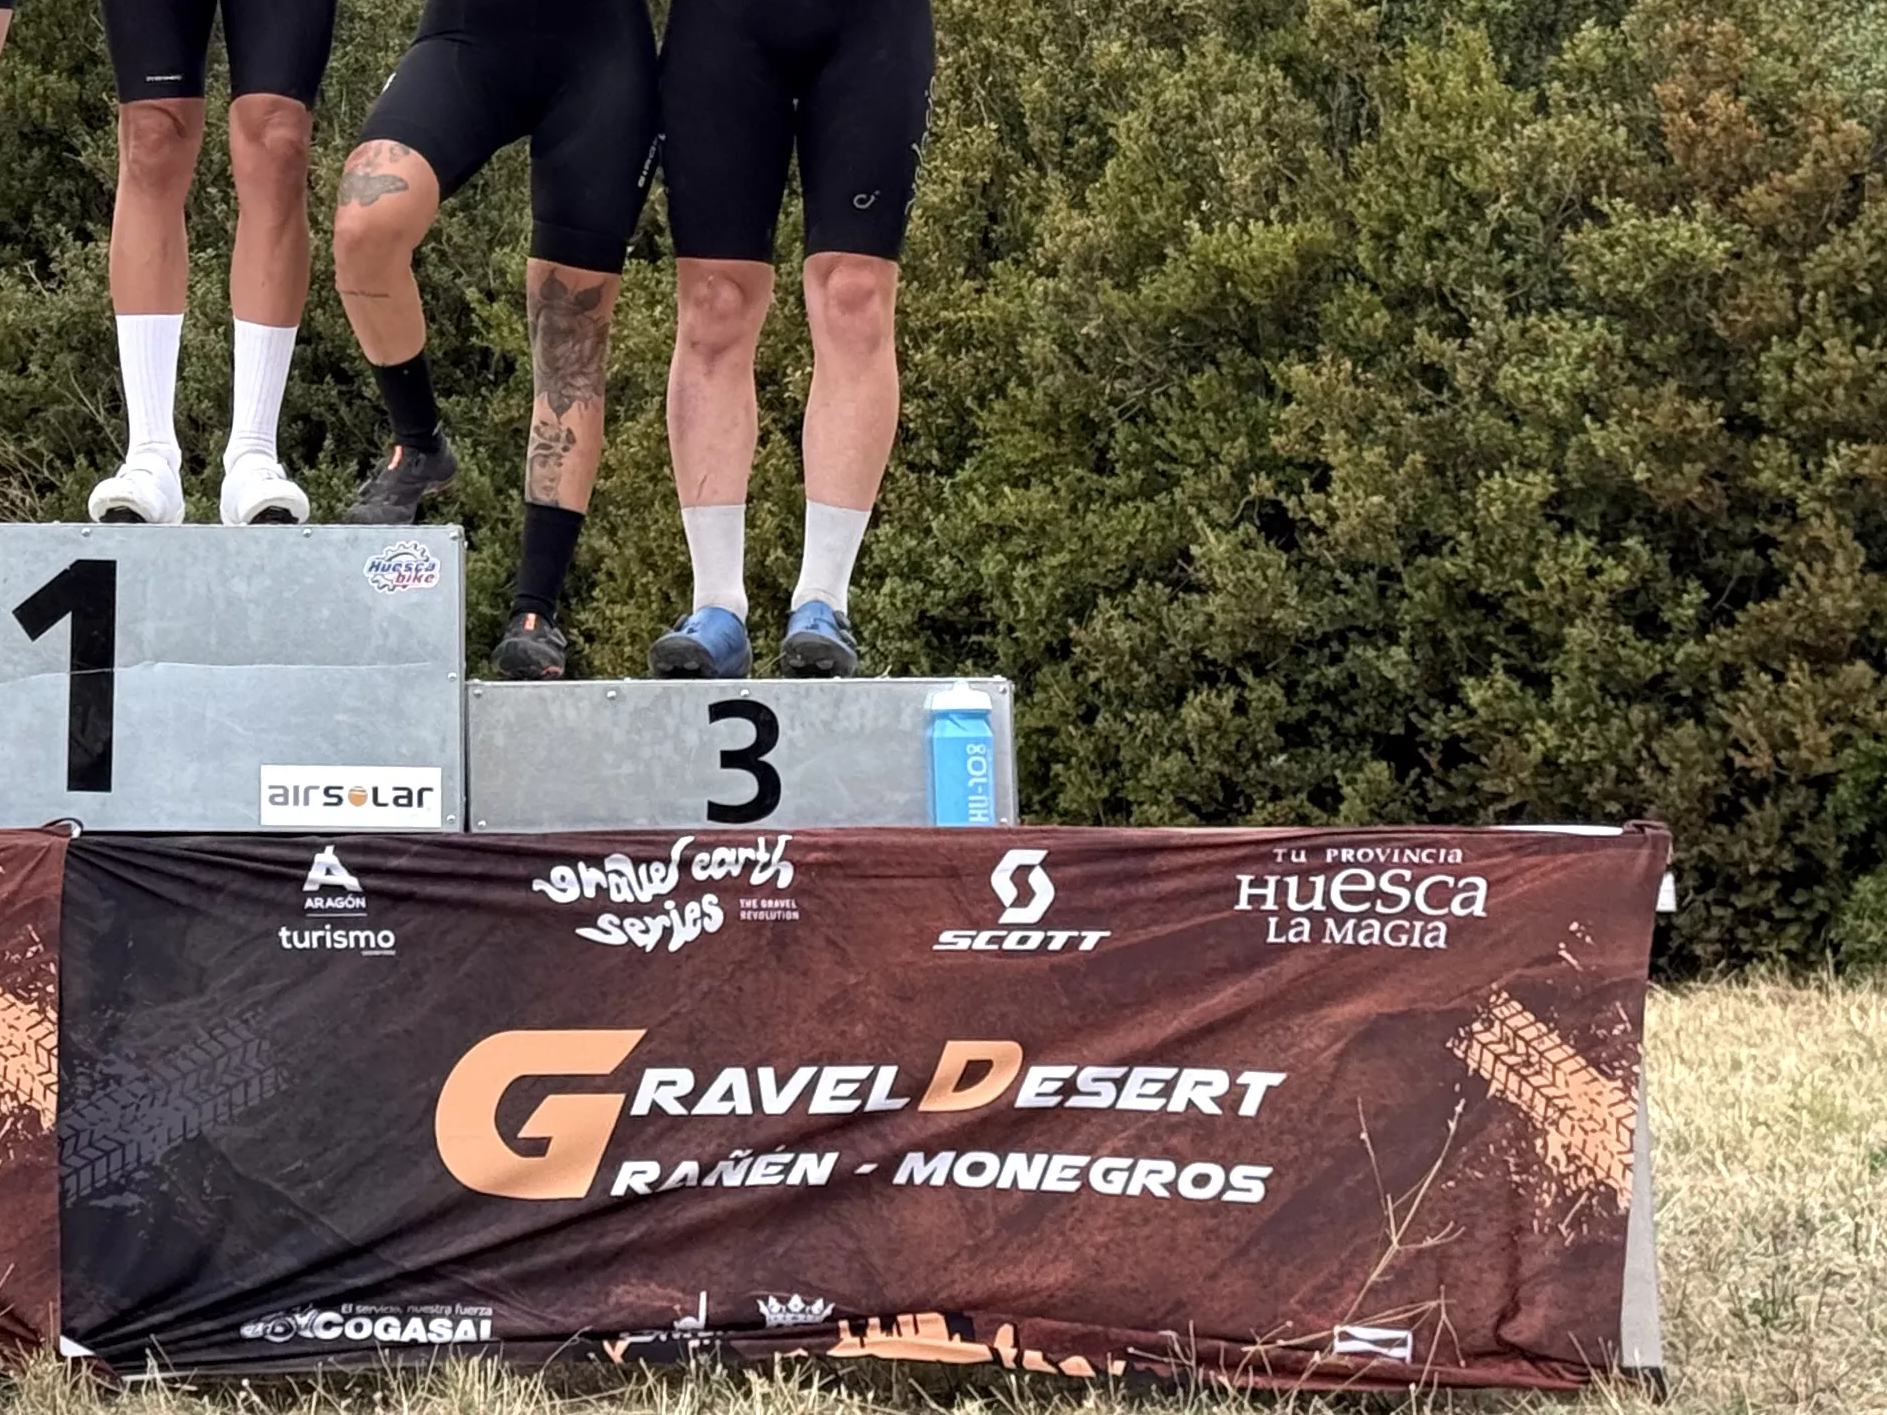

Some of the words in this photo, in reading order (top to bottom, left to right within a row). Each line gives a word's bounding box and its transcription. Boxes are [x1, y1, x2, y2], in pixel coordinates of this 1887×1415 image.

[368, 560, 436, 573] Huesca
[11, 559, 117, 793] 1
[705, 699, 782, 824] 3
[532, 835, 695, 904] gravel
[691, 834, 795, 889] earth
[304, 893, 367, 910] ARAGÓN
[740, 898, 758, 910] THE
[760, 898, 798, 910] GRAVEL
[575, 893, 725, 953] series
[739, 910, 800, 922] REVOLUTION
[278, 923, 396, 950] turismo
[932, 930, 1112, 951] SCOTT
[434, 1028, 912, 1200] GRAVEL
[918, 1040, 1288, 1117] DESERT
[892, 1150, 1274, 1204] MONEGROS
[341, 1303, 353, 1315] El
[407, 1303, 452, 1316] nuestra
[455, 1302, 494, 1316] fuerza
